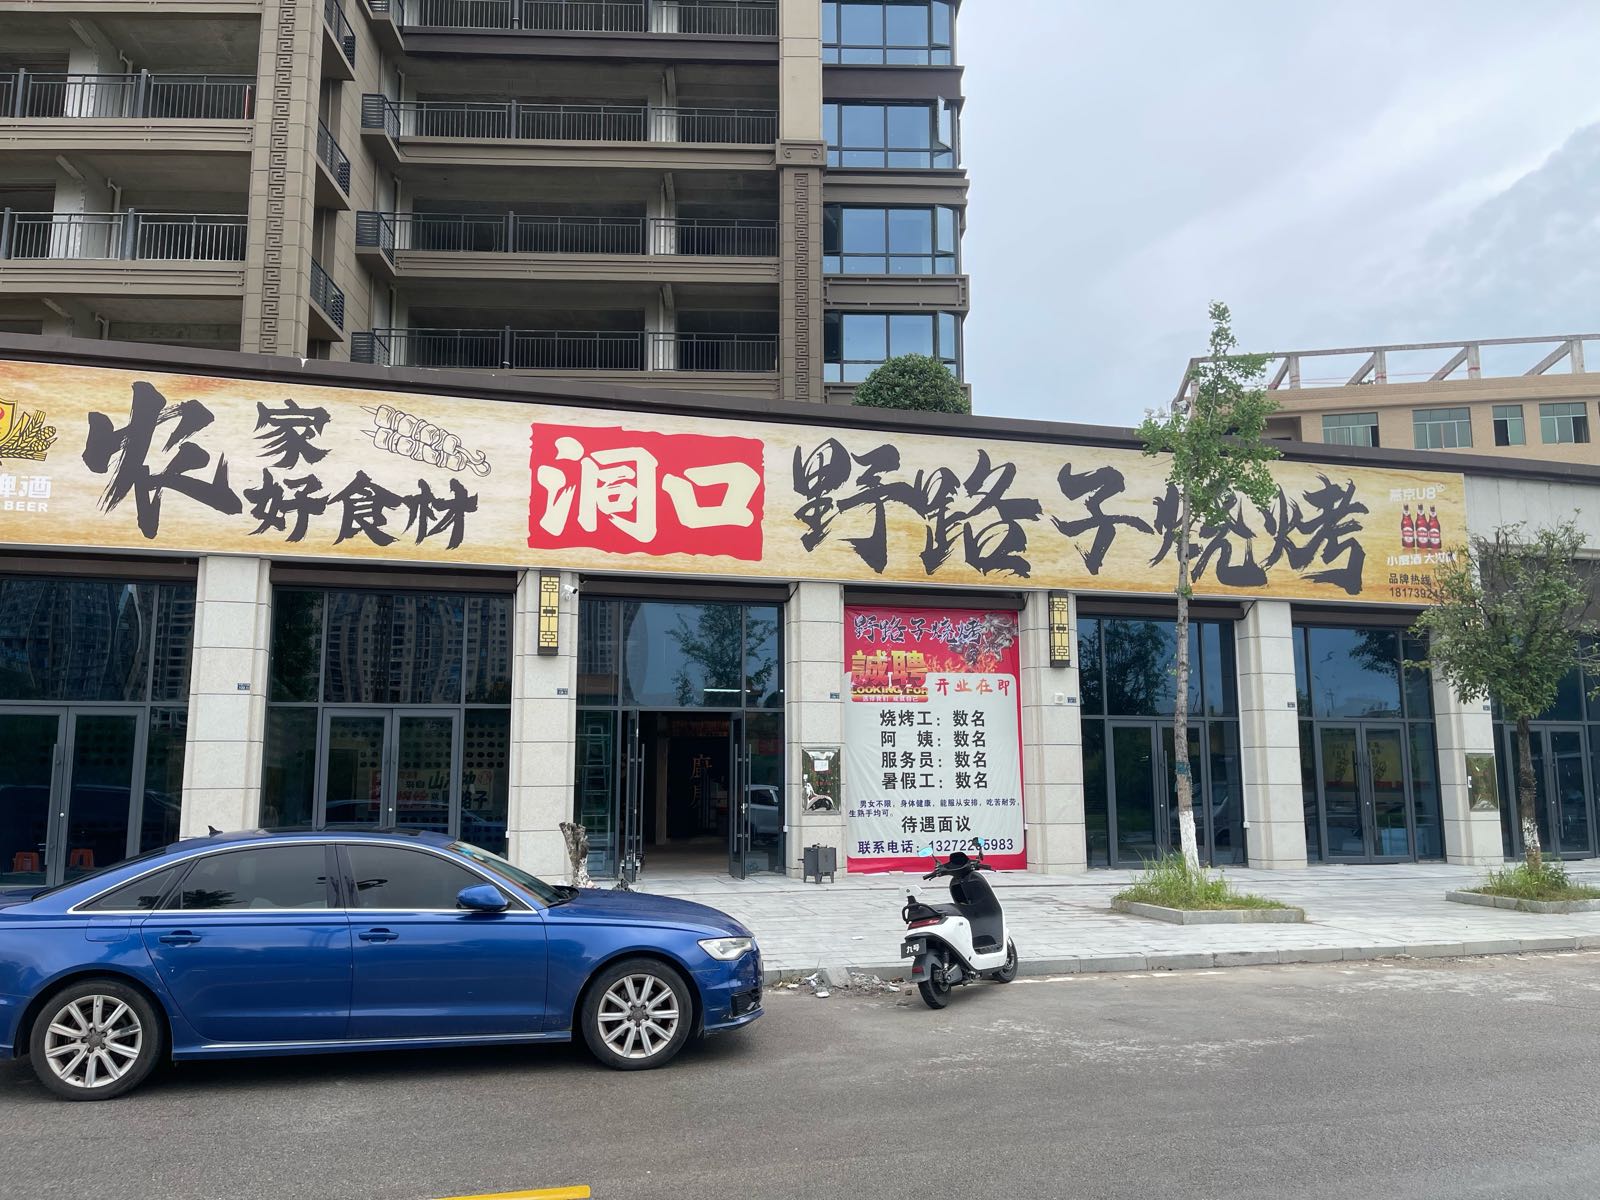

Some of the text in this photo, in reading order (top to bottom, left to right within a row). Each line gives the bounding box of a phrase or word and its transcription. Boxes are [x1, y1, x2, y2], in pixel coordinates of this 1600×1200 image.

[537, 437, 760, 543] 洞口
[4, 500, 48, 512] BEER
[243, 470, 478, 549] 好食材
[792, 437, 1369, 596] 野路子烧烤
[853, 614, 985, 645] 野路子烧烤
[851, 650, 928, 687] 誠聘
[851, 686, 928, 695] LOOKING FOR
[934, 678, 1010, 696] 开业在即
[902, 816, 971, 833] 待遇面议
[906, 944, 920, 954] 九号
